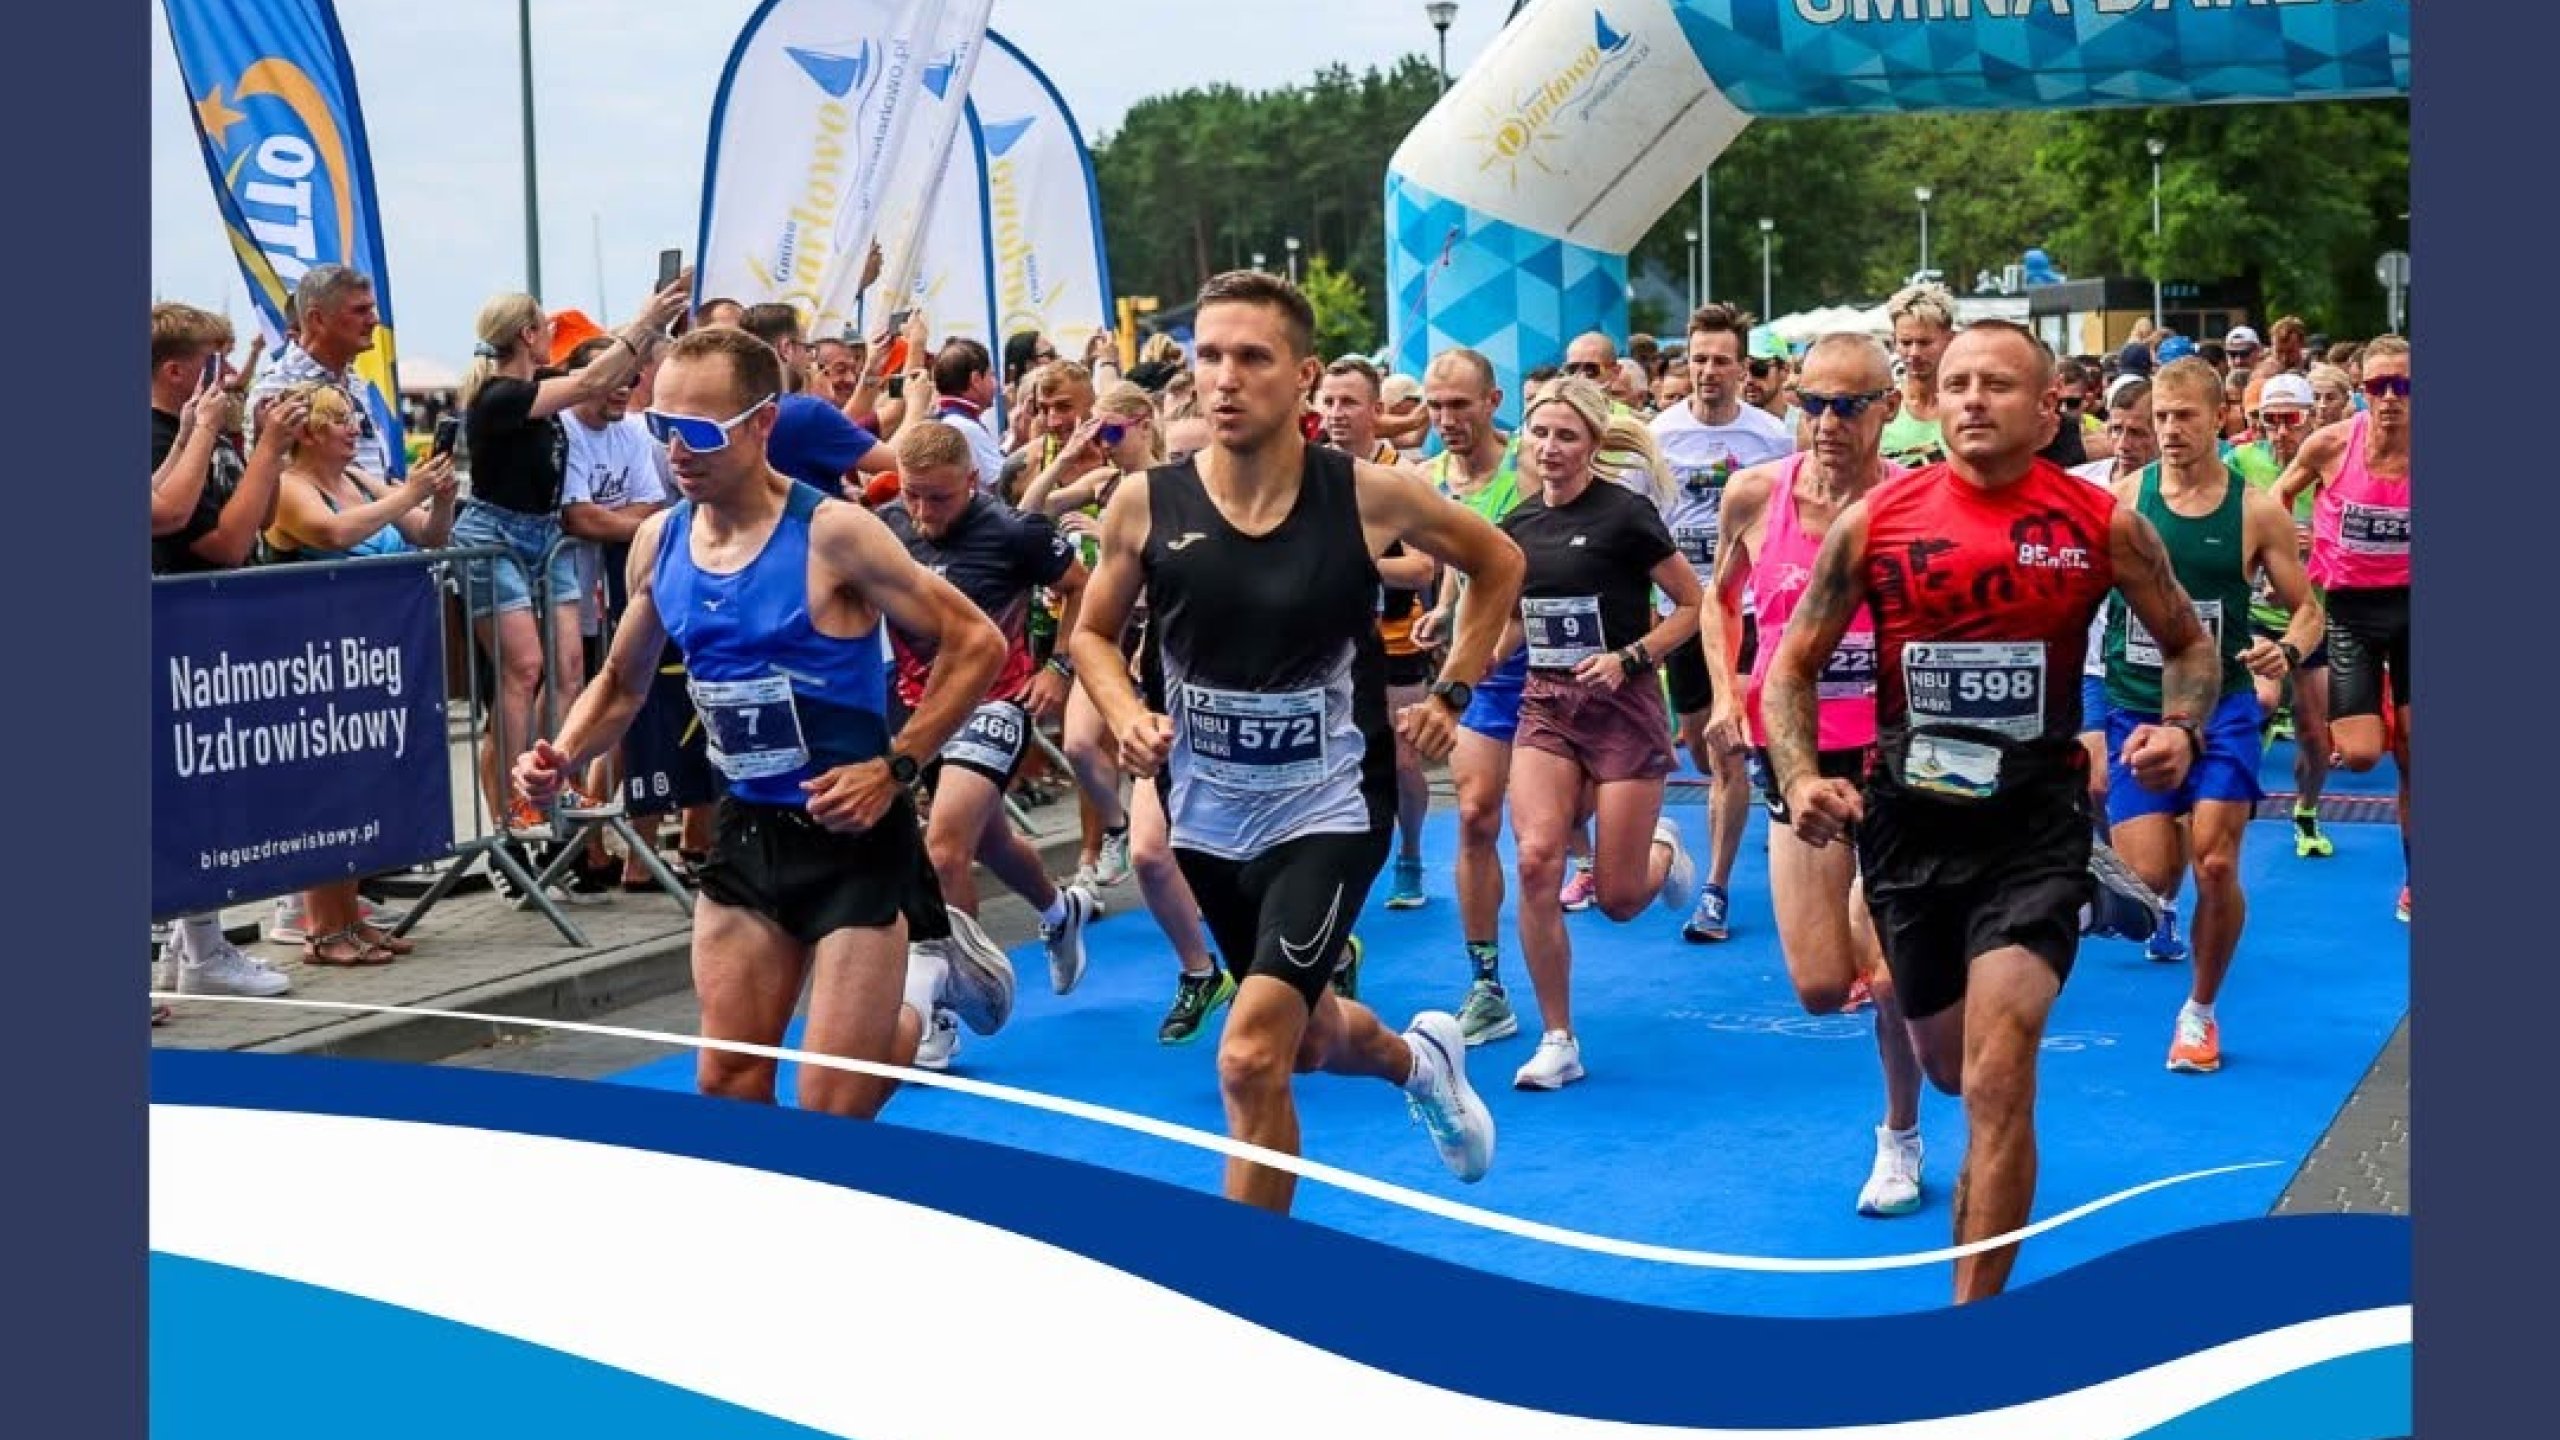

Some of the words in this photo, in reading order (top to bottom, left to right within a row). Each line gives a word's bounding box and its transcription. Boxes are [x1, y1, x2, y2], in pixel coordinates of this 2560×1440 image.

[1562, 616, 1580, 638] 9
[1908, 648, 1932, 664] 12
[170, 641, 334, 711] Nadmorski
[340, 635, 402, 696] Bieg
[1911, 671, 1950, 688] NBU
[1959, 669, 2034, 702] 598
[1187, 689, 1211, 707] 12
[738, 707, 760, 735] 7
[1190, 711, 1230, 735] NBU
[1238, 716, 1316, 751] 572
[173, 702, 408, 778] Uzdrowiskowy
[200, 819, 380, 870] bieguzdrowiskowy.pl
